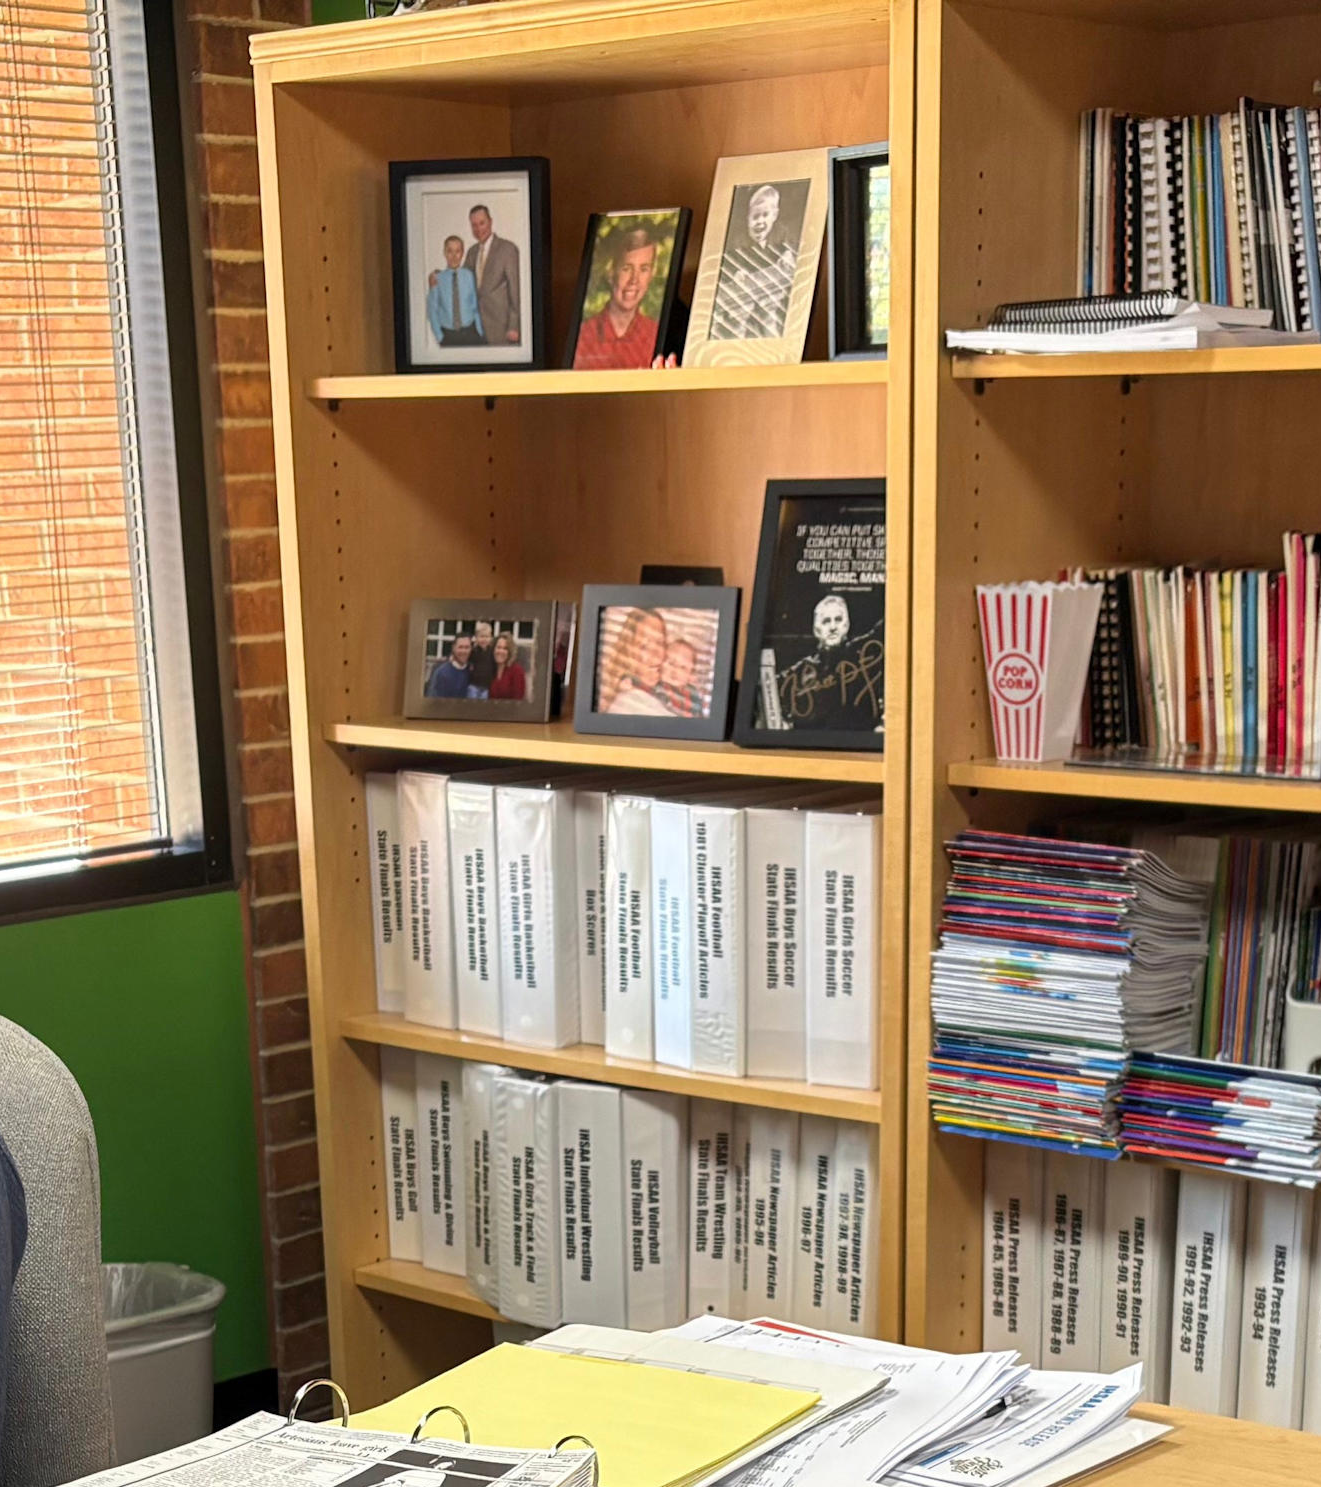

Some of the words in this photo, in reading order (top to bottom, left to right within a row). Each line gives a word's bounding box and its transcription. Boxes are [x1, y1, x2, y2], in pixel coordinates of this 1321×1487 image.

[998, 678, 1033, 689] CORN
[1003, 665, 1027, 677] POP
[767, 864, 778, 897] State
[785, 868, 796, 904] IHSAA
[826, 870, 837, 903] State
[843, 876, 853, 912] IHSAA
[587, 890, 596, 911] Box
[767, 900, 777, 938] Finals
[587, 914, 596, 955] Scores
[784, 908, 795, 939] Boys
[826, 907, 837, 945] Finals
[843, 916, 853, 946] Girls
[767, 941, 777, 989] Results
[784, 942, 795, 987] Soccer
[826, 949, 836, 997] Results
[843, 950, 852, 996] Soccer
[564, 1148, 575, 1177] State
[579, 1128, 590, 1161] IHSAA
[698, 1139, 710, 1169] State
[716, 1132, 728, 1166] IHSAA
[632, 1159, 642, 1189] State
[714, 1169, 726, 1200] Team
[771, 1149, 781, 1183] IHSAA
[817, 1155, 828, 1189] IHSAA
[854, 1167, 864, 1203] IHSAA
[565, 1181, 575, 1214] Finals
[580, 1165, 590, 1222] Individual
[648, 1170, 659, 1203] IHSAA
[698, 1173, 709, 1206] Finals
[632, 1192, 642, 1226] Finals
[754, 1198, 765, 1246] 1995-96
[769, 1186, 779, 1252] Newspaper
[815, 1193, 826, 1259] Newspaper
[1009, 1199, 1019, 1233] IHSAA
[1070, 1208, 1082, 1246] IHSAA
[566, 1217, 575, 1259] Results
[648, 1206, 660, 1264] Volleyball
[697, 1209, 707, 1252] Results
[712, 1203, 725, 1259] Wrestling
[801, 1206, 811, 1253] 1996-97
[852, 1207, 863, 1274] Newspaper
[1134, 1217, 1145, 1254] IHSAA
[580, 1226, 591, 1281] Wrestling
[633, 1230, 642, 1271] Results
[1009, 1237, 1019, 1272] Press
[1069, 1248, 1080, 1283] Press
[1117, 1231, 1129, 1284] 1989-90,
[1201, 1231, 1214, 1269] IHSAA
[1274, 1245, 1286, 1282] IHSAA
[767, 1254, 777, 1299] Articles
[814, 1261, 823, 1307] Articles
[1132, 1257, 1143, 1294] Press
[1184, 1245, 1197, 1297] 1991-92,
[851, 1276, 860, 1322] Articles
[1008, 1275, 1018, 1332] Releases
[1199, 1272, 1211, 1309] Press
[1271, 1286, 1283, 1324] Press
[1066, 1287, 1078, 1344] Releases
[1116, 1288, 1127, 1338] 1990-91
[1130, 1297, 1142, 1355] Releases
[1181, 1301, 1194, 1353] 1992-93
[1252, 1287, 1266, 1340] 1993-94
[1195, 1313, 1208, 1372] Releases
[1266, 1327, 1280, 1387] Releases
[1079, 1385, 1120, 1410] IHSAA
